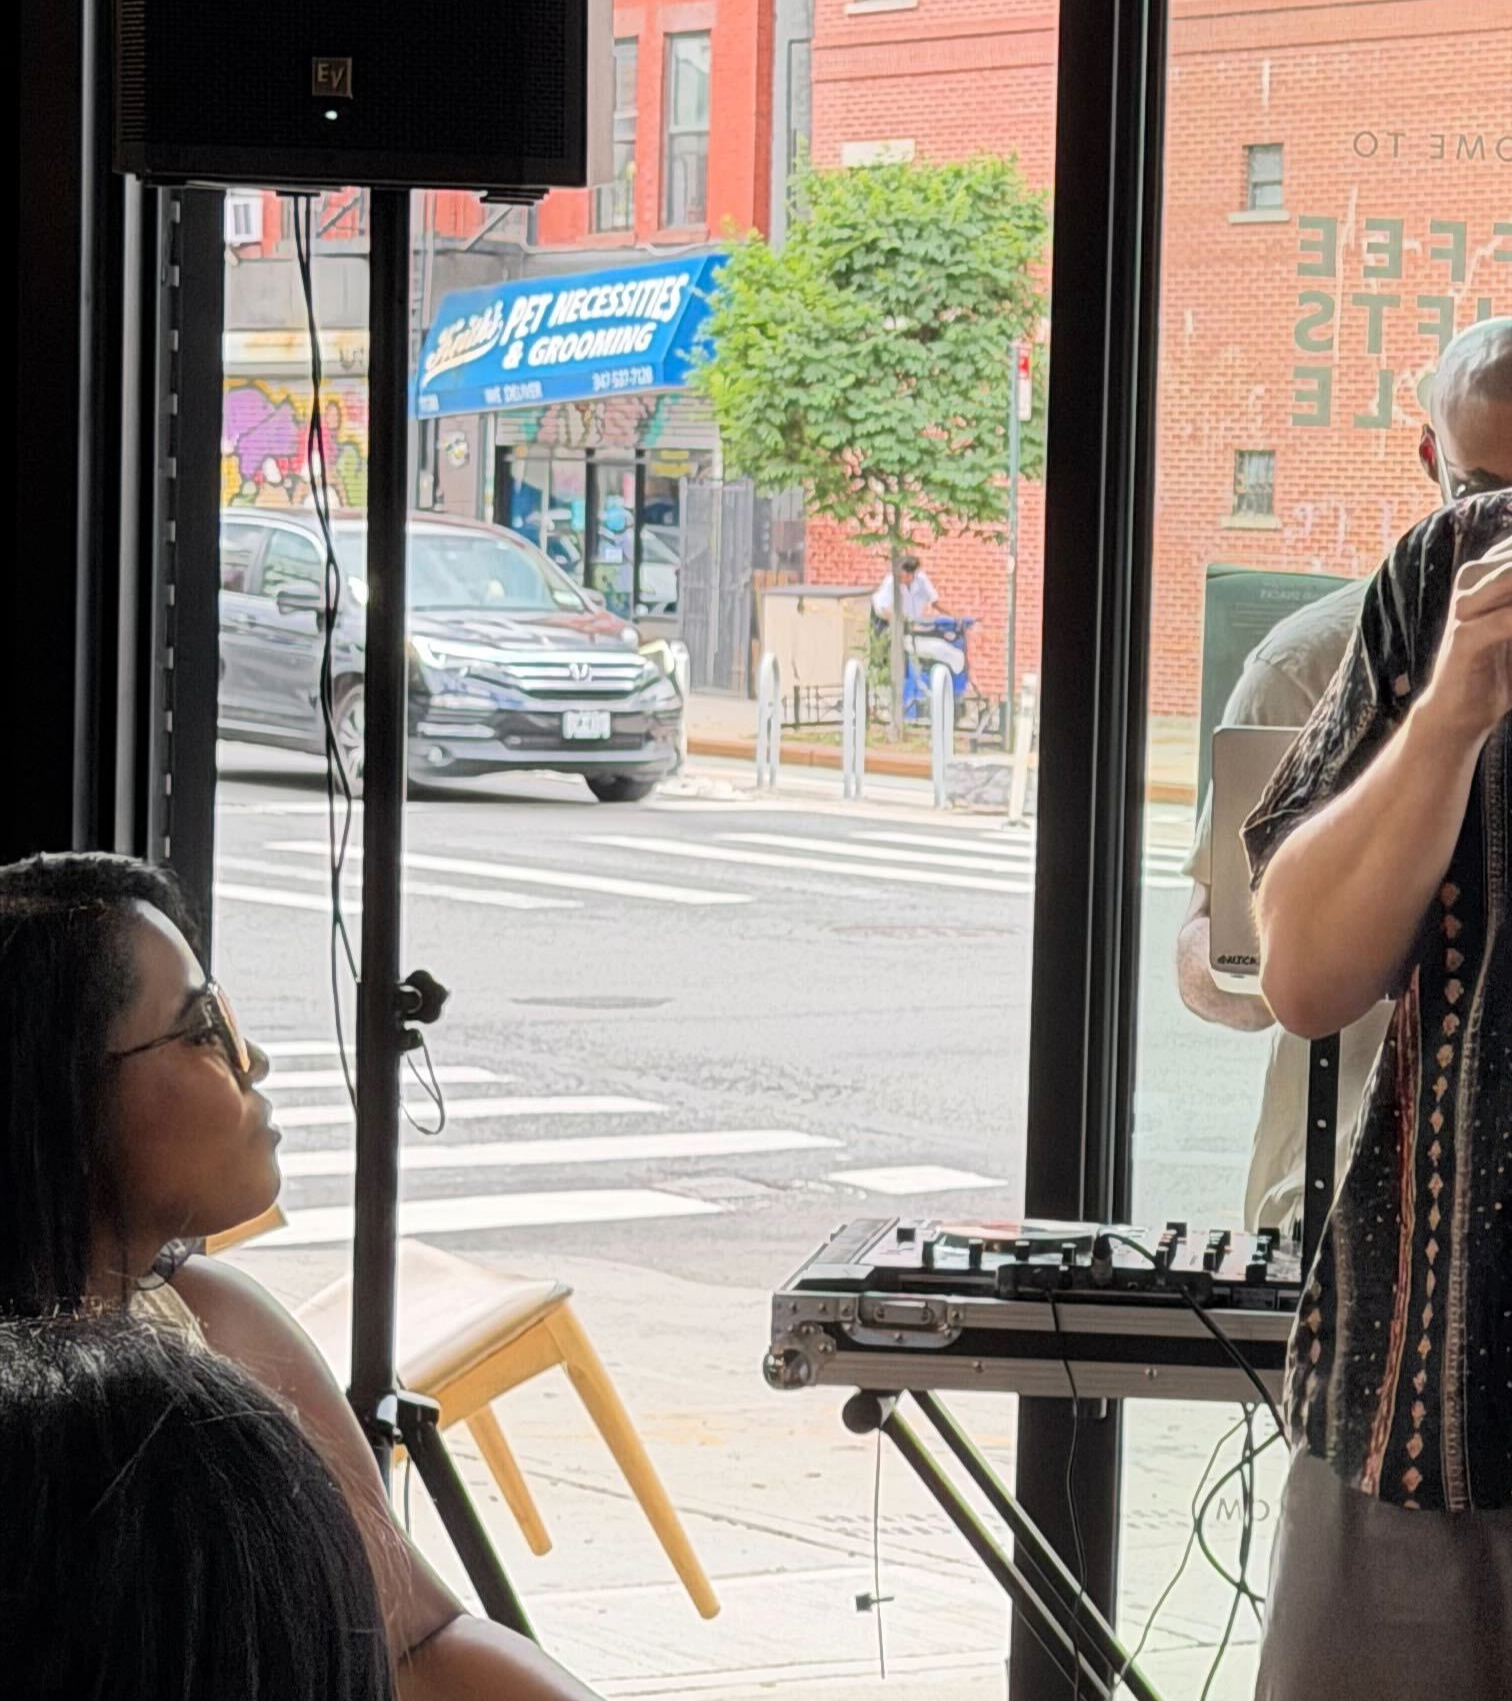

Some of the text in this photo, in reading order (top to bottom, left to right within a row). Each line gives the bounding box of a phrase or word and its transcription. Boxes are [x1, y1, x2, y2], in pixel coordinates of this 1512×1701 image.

[500, 273, 689, 346] PET NECESSITIES
[503, 322, 657, 369] & GROOMING
